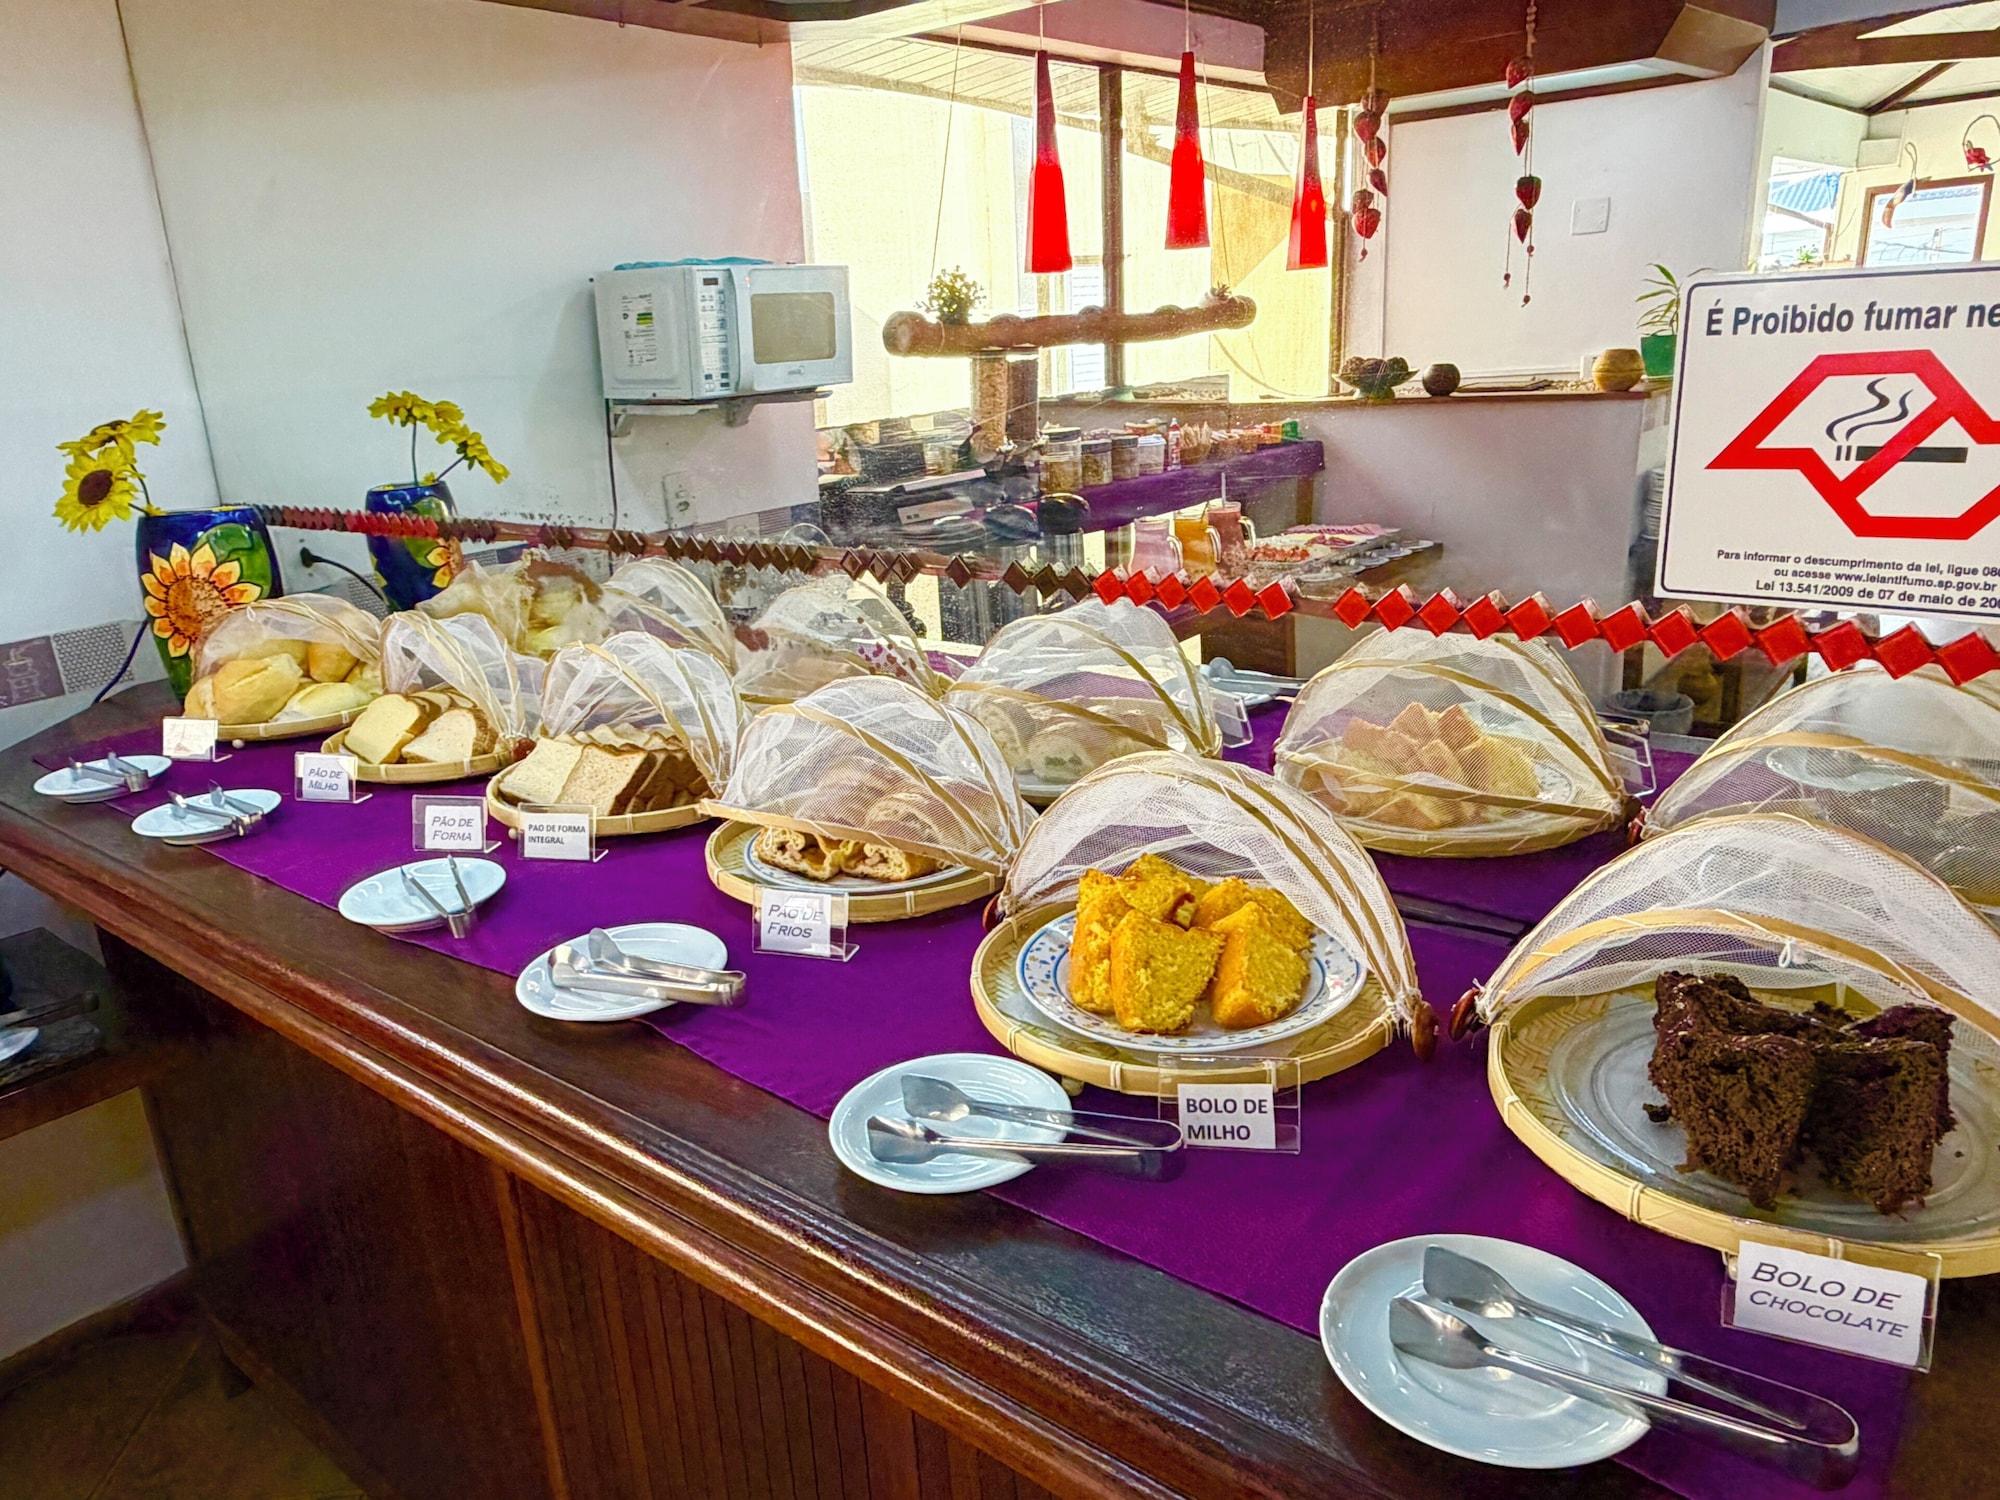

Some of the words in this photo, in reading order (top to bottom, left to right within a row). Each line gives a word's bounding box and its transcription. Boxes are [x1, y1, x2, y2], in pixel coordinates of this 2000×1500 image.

[1705, 299, 1724, 336] É
[1732, 303, 1854, 335] Proibido
[1864, 301, 1957, 332] fumar
[1717, 549, 1741, 560] Para
[1744, 551, 1791, 564] informar
[1794, 556, 1801, 564] o
[1804, 555, 1903, 571] descumprimento
[1907, 562, 1922, 572] da
[1926, 563, 1943, 575] lei,
[1947, 564, 1979, 577] ligue
[1774, 568, 1788, 576] ou
[1792, 570, 1831, 580] acesse
[1835, 573, 1997, 592] www.leiantifumo.sp.gov.br
[1756, 580, 1775, 591] Lei
[1779, 582, 1854, 598] 13.541/2009
[1857, 588, 1874, 599] de
[1878, 589, 1894, 600] 07
[1898, 590, 1915, 602] de
[1919, 594, 1953, 605] maio
[1958, 595, 1975, 607] de
[329, 769, 344, 779] DE
[308, 780, 339, 791] MILHO
[432, 815, 456, 827] PÃO
[458, 818, 474, 827] DE
[546, 825, 555, 833] DE
[557, 825, 586, 833] FORMA
[432, 830, 472, 841] FORMA
[528, 836, 565, 845] INTEGRAL
[767, 922, 813, 938] FRIOS
[1186, 1098, 1237, 1114] BOLO
[1244, 1098, 1268, 1114] DE
[1187, 1125, 1251, 1140] MILHO
[1751, 1262, 1845, 1297] BOLO
[1853, 1286, 1902, 1310] DE
[1750, 1290, 1908, 1338] CHOCOLATE
